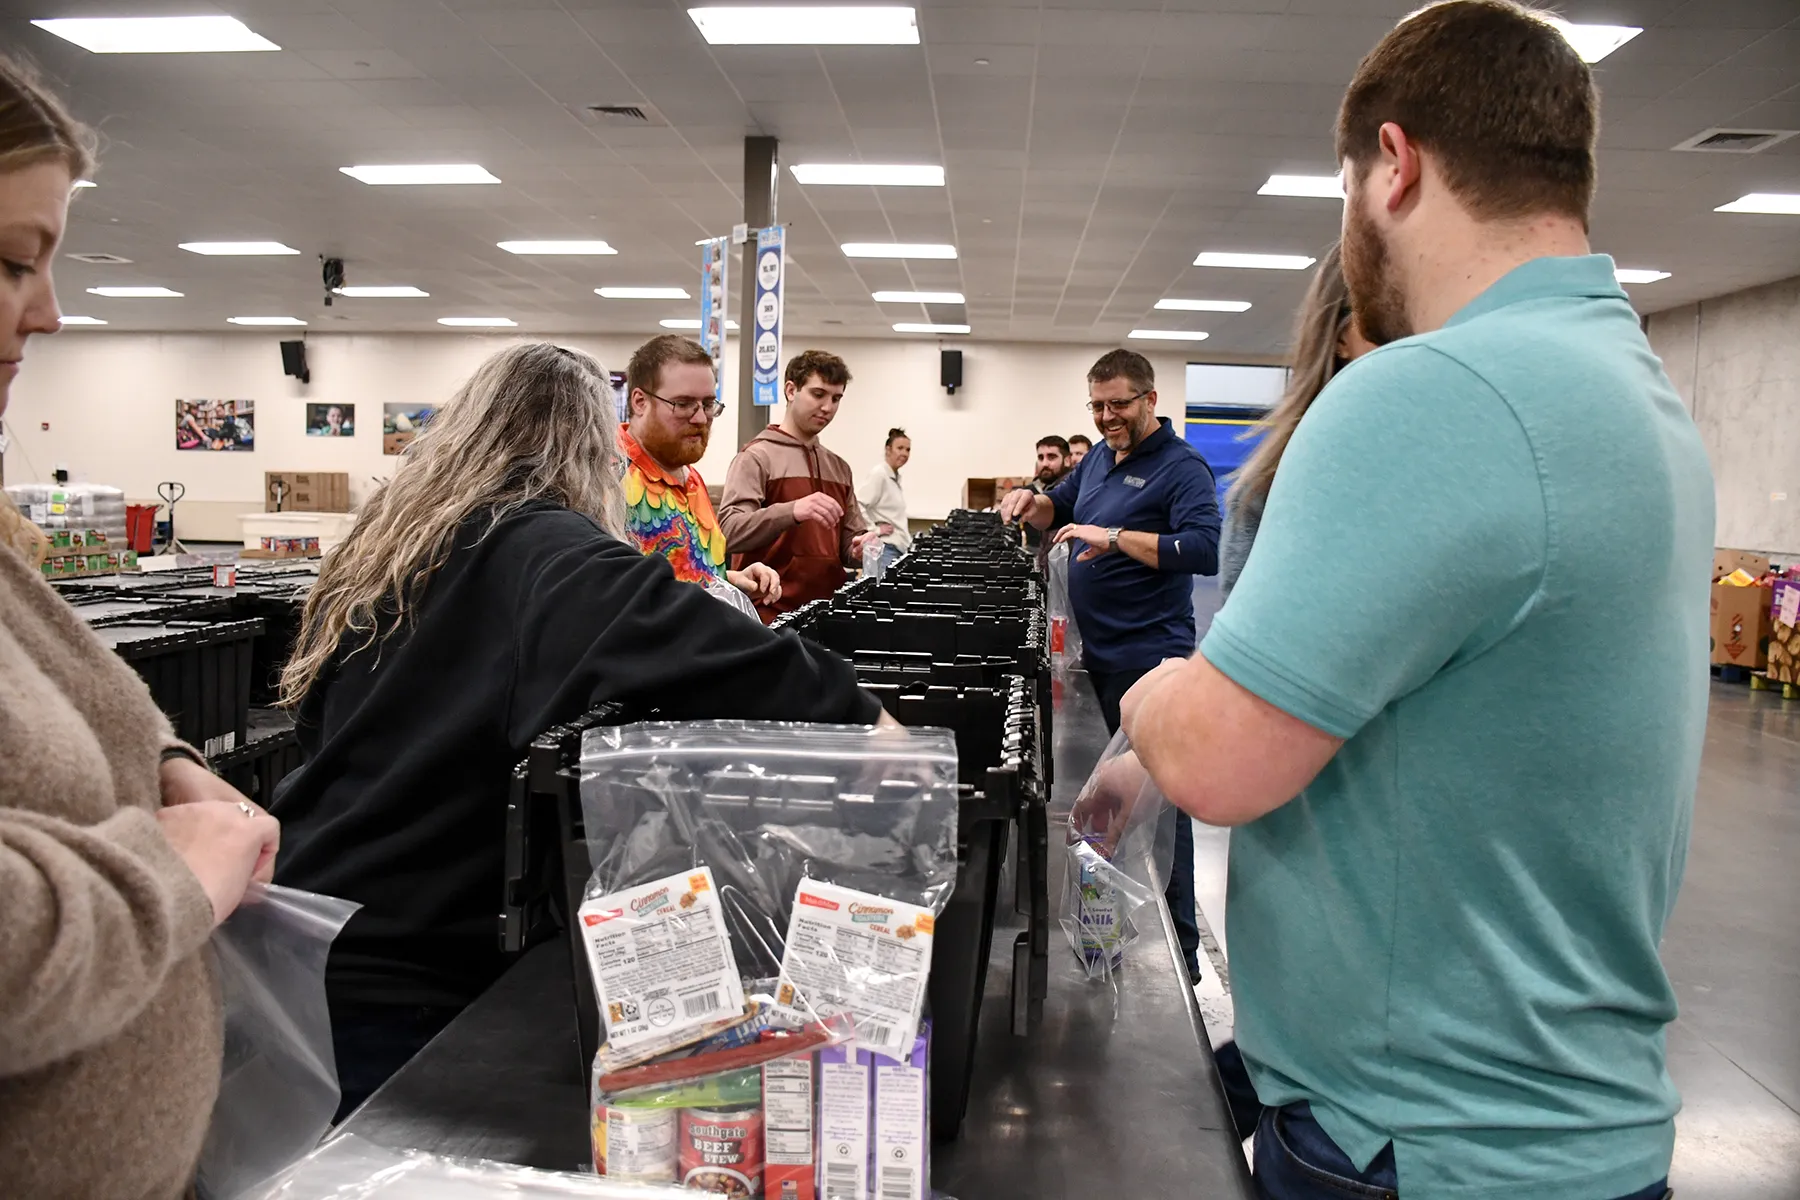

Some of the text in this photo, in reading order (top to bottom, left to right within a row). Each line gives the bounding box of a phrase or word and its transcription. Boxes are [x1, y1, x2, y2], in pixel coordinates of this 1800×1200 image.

[630, 886, 669, 911] Cinnamon
[848, 902, 894, 915] Cinnamon
[1082, 914, 1114, 925] Milk
[869, 923, 890, 935] CEREAL
[623, 956, 636, 964] 120
[689, 1123, 747, 1140] Southgate
[694, 1138, 733, 1154] BEEF
[703, 1153, 739, 1165] STEW
